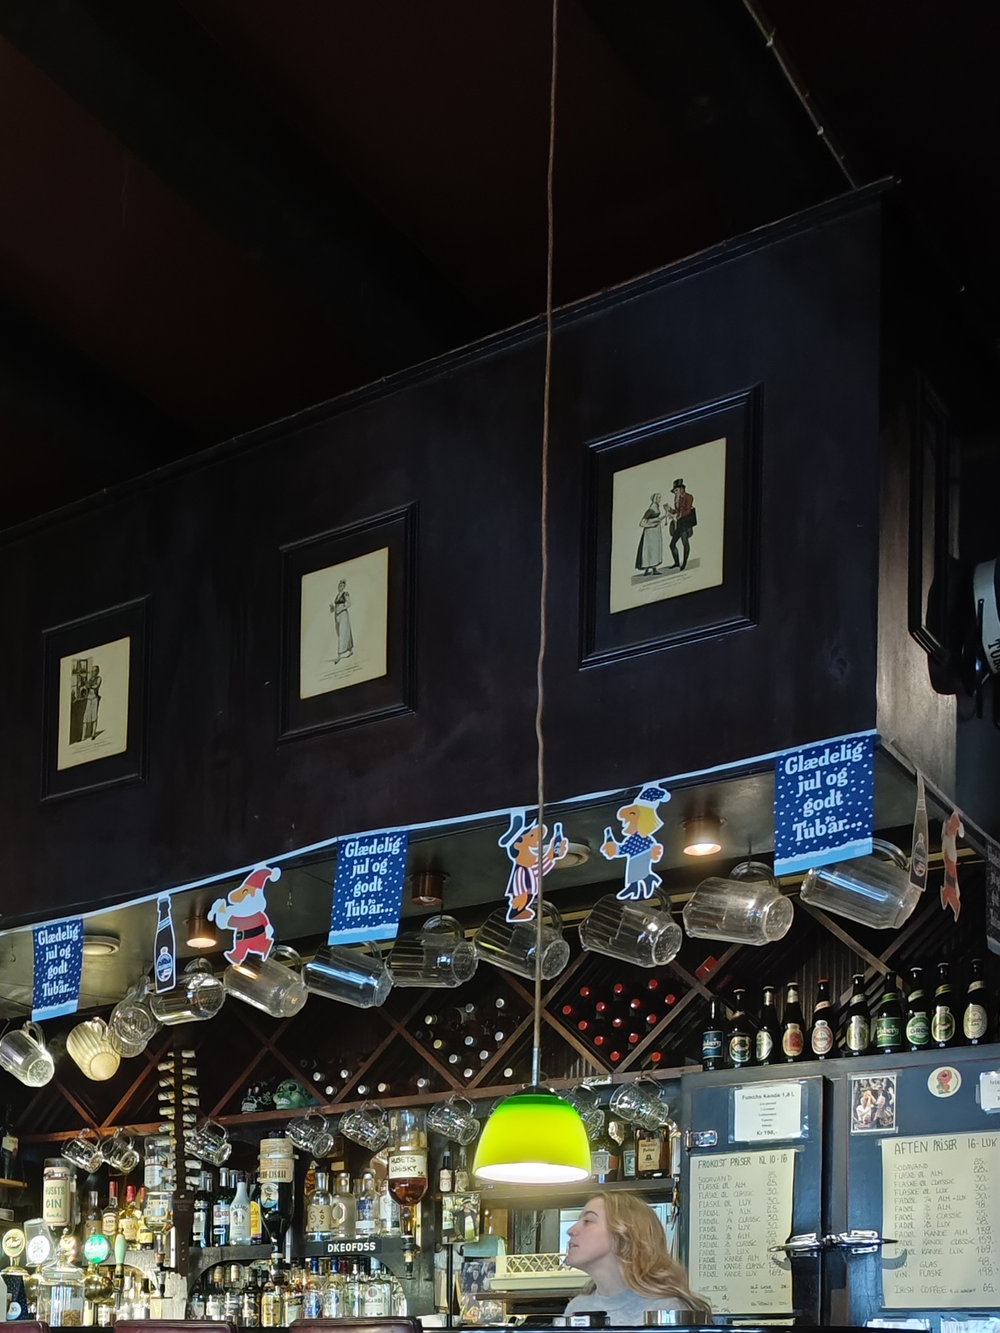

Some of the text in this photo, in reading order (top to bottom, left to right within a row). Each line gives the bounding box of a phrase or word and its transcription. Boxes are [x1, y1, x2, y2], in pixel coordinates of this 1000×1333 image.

[785, 742, 864, 775] Glædelig
[796, 767, 848, 797] jul og
[803, 789, 844, 817] godt
[345, 837, 401, 857] Glædelig
[350, 858, 388, 879] jul og
[353, 875, 383, 897] godt
[38, 925, 80, 945] Glædelig
[44, 944, 71, 963] jul og
[47, 959, 68, 980] godt
[894, 1141, 928, 1155] AFTEN
[933, 1138, 957, 1151] PRISER
[46, 1199, 62, 1209] GIN
[327, 1241, 376, 1253] DKEOFDSS
